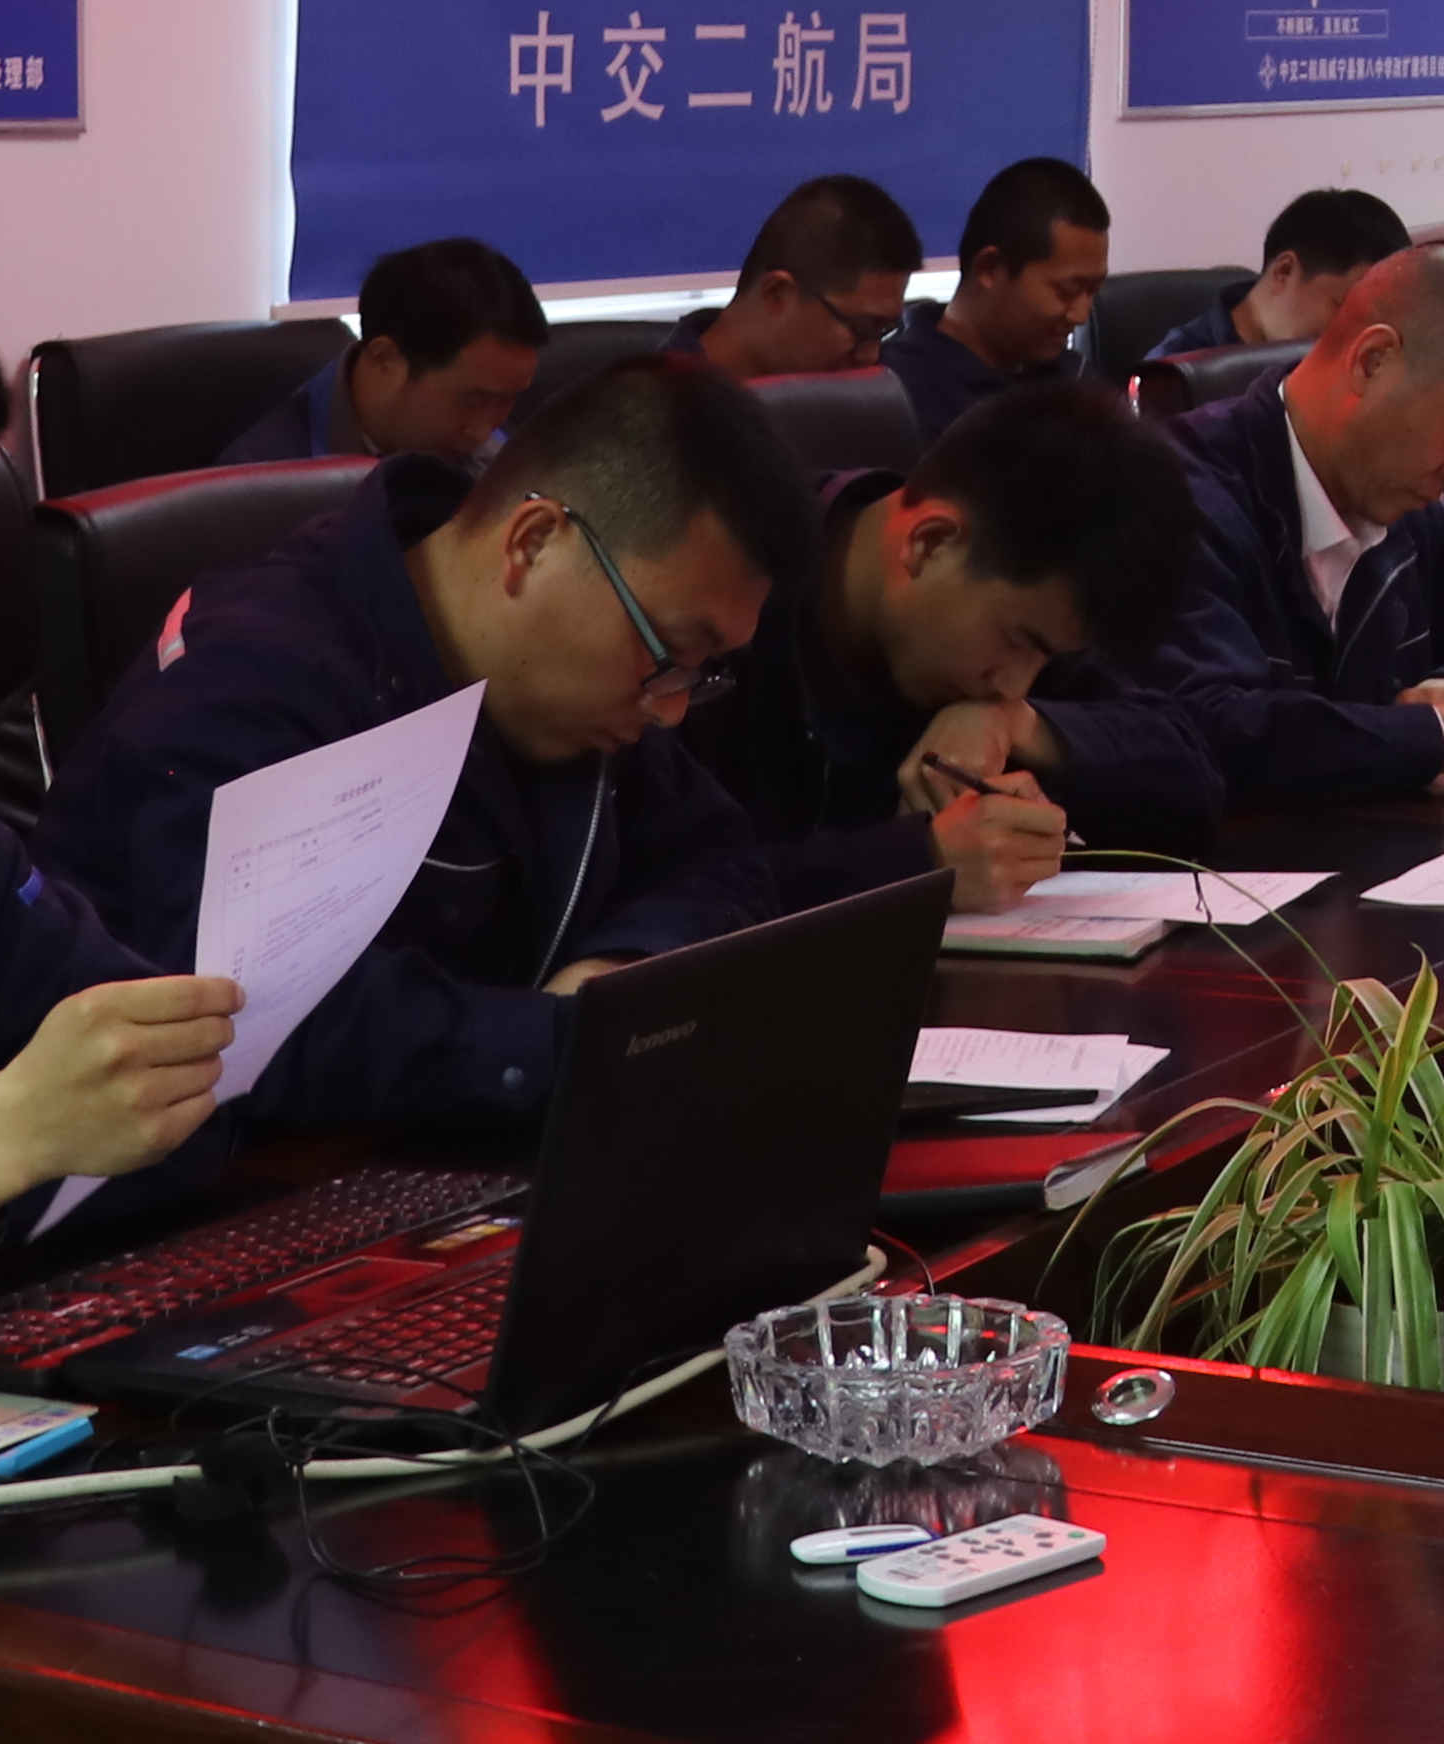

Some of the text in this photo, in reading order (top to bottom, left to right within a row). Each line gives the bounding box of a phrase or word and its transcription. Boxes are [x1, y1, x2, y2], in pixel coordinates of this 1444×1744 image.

[508, 10, 913, 128] 中交二航局
